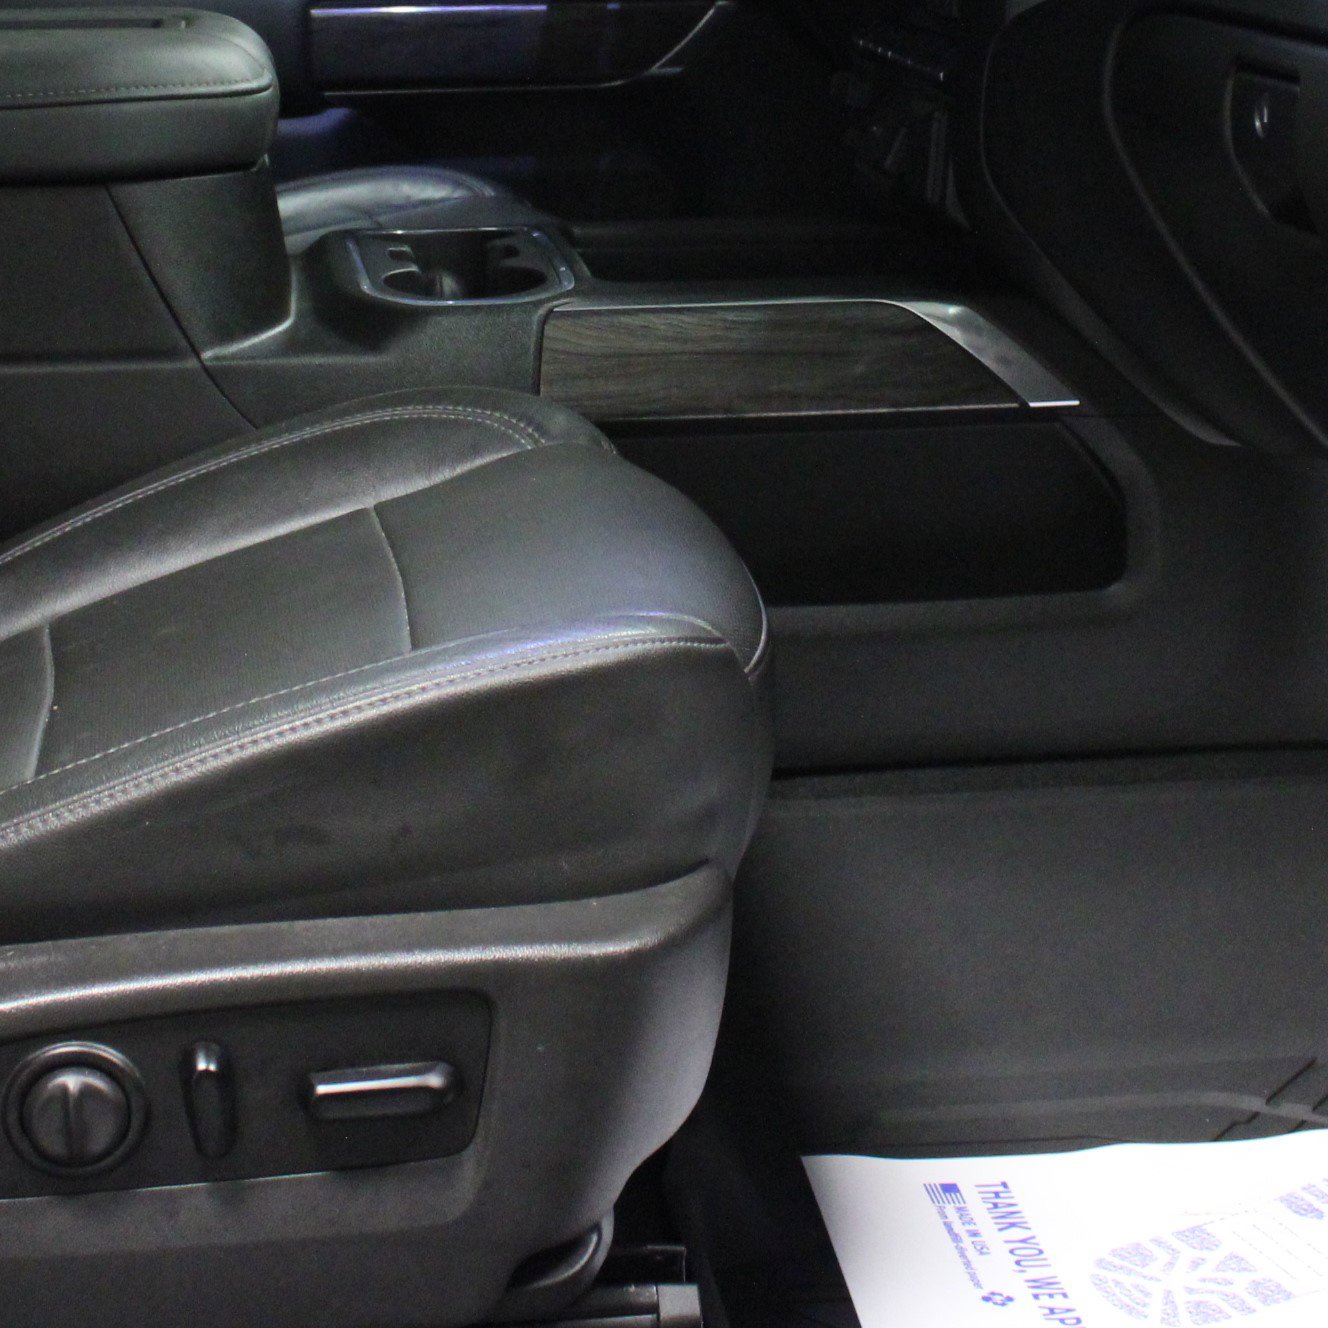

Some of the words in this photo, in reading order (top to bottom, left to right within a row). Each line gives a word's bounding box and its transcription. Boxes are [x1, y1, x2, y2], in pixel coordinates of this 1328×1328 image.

[954, 1206, 977, 1226] MADE
[974, 1181, 1032, 1232] THANK
[965, 1229, 983, 1238] IN
[971, 1240, 992, 1256] USA
[1003, 1235, 1053, 1273] YOU,
[1023, 1275, 1070, 1300] WE
